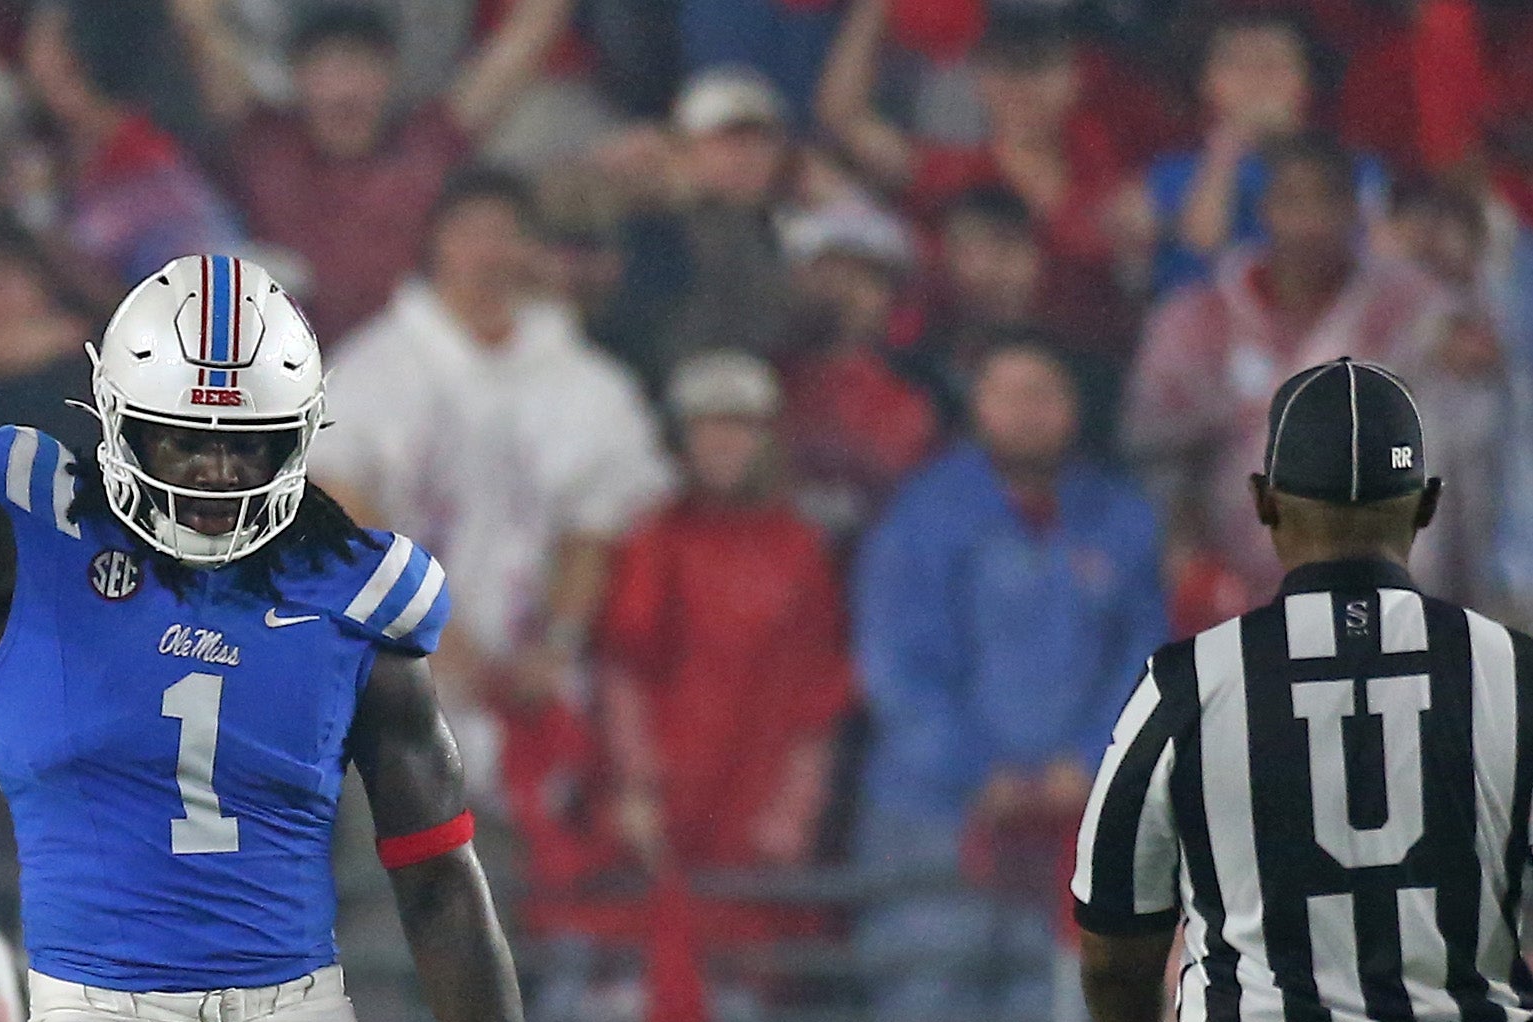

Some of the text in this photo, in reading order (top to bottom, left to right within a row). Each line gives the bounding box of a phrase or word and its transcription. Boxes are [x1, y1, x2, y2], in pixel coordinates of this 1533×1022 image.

[190, 388, 242, 406] REBS
[1392, 446, 1412, 469] RR
[91, 550, 138, 598] SEC
[159, 623, 240, 666] Ole Miss
[161, 671, 239, 854] 1
[1290, 673, 1432, 869] U
